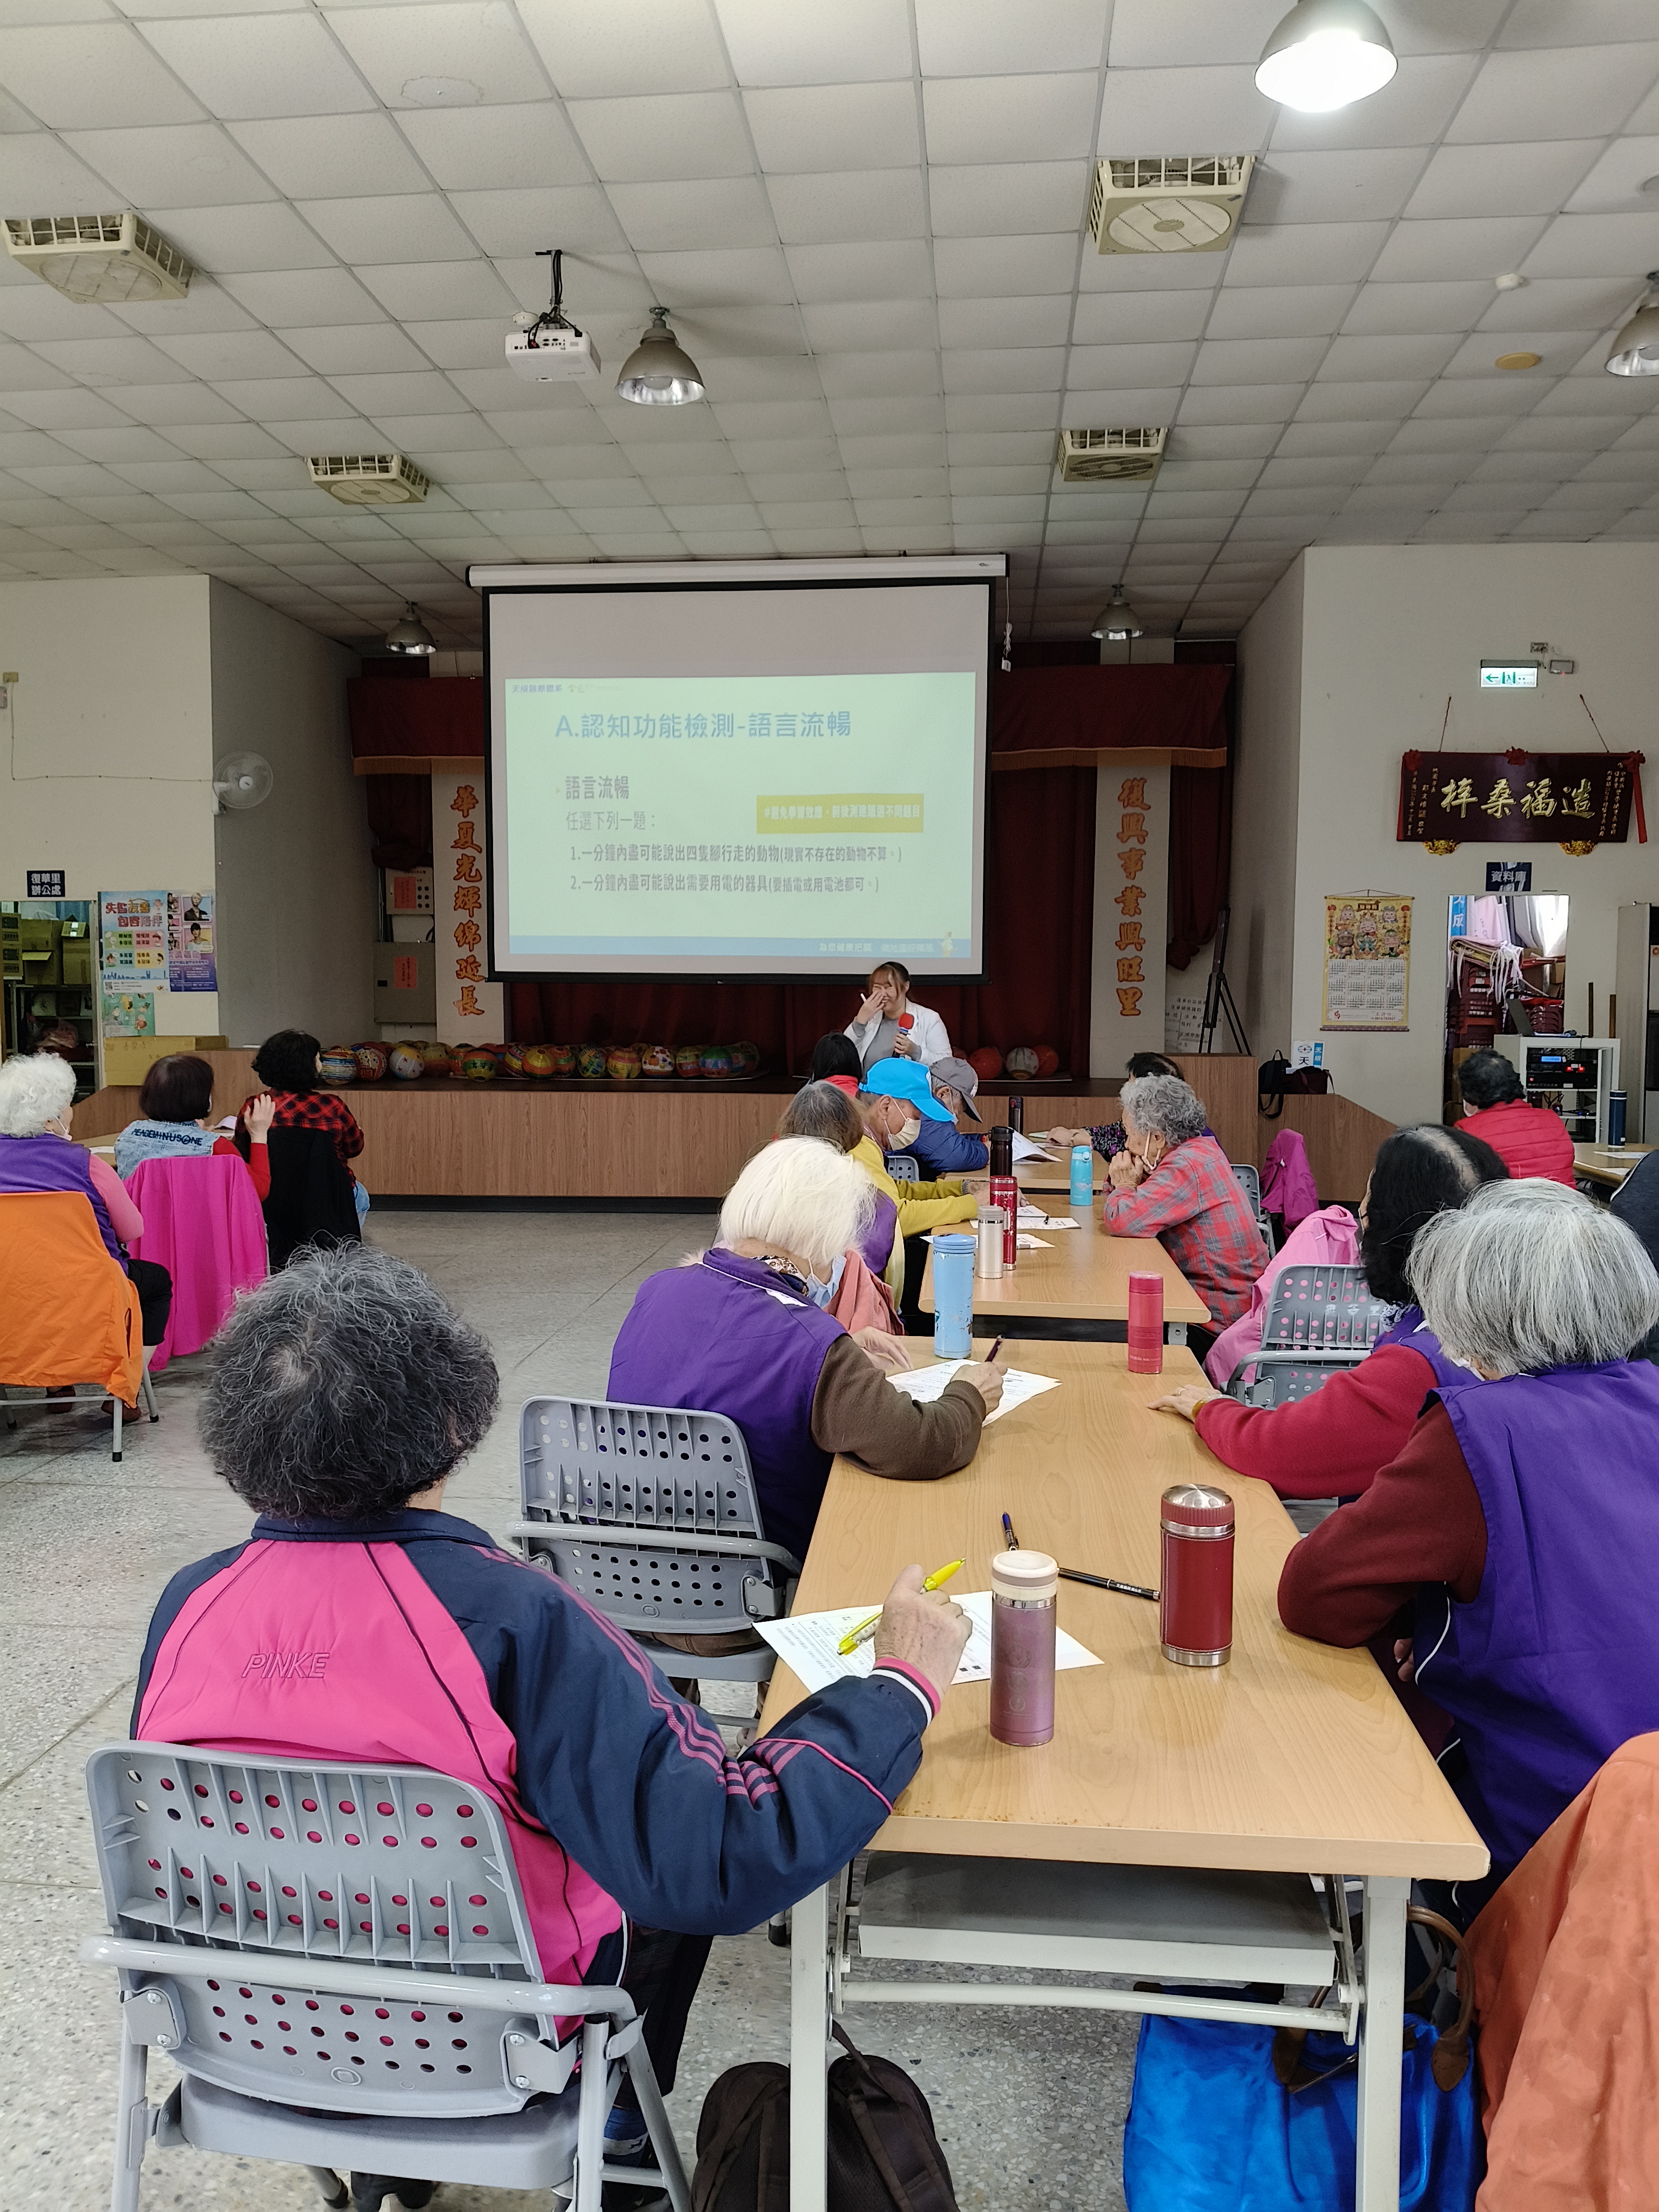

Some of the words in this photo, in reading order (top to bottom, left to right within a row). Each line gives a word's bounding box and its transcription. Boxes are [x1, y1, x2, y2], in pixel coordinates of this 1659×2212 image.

[565, 775, 629, 799] 語言流暢
[31, 873, 61, 884] 復華里
[1491, 871, 1527, 882] 資料庫
[31, 885, 62, 896] 辦公處
[241, 1653, 330, 1678] PINKE
